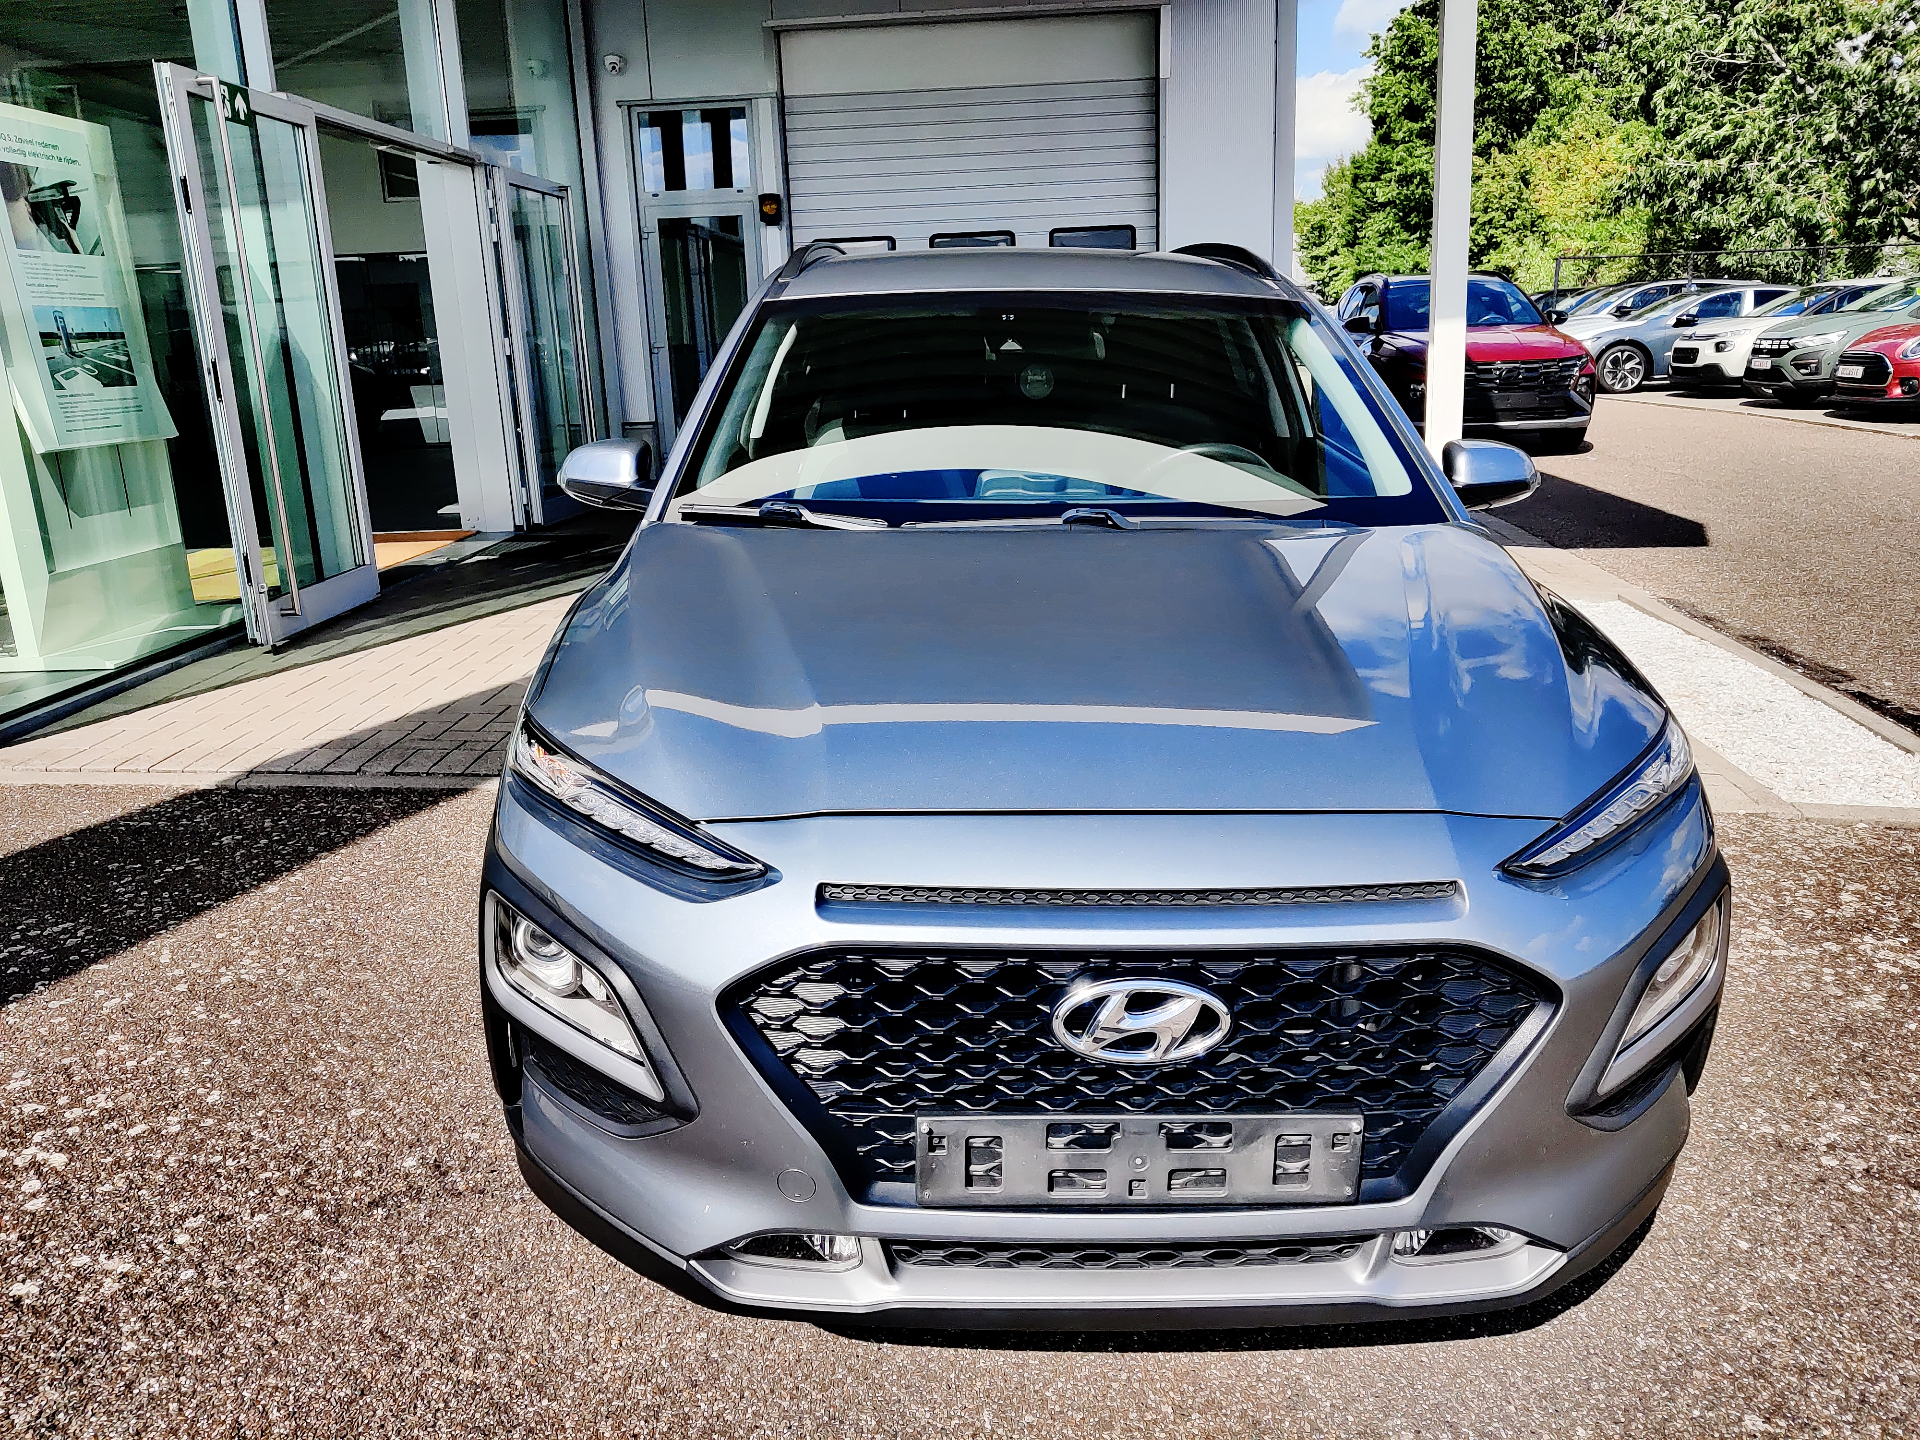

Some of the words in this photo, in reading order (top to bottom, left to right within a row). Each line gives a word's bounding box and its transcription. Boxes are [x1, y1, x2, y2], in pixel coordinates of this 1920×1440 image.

[35, 140, 59, 151] redenen
[28, 150, 56, 161] elektrisch
[56, 155, 63, 163] te
[63, 156, 81, 166] rijden.
